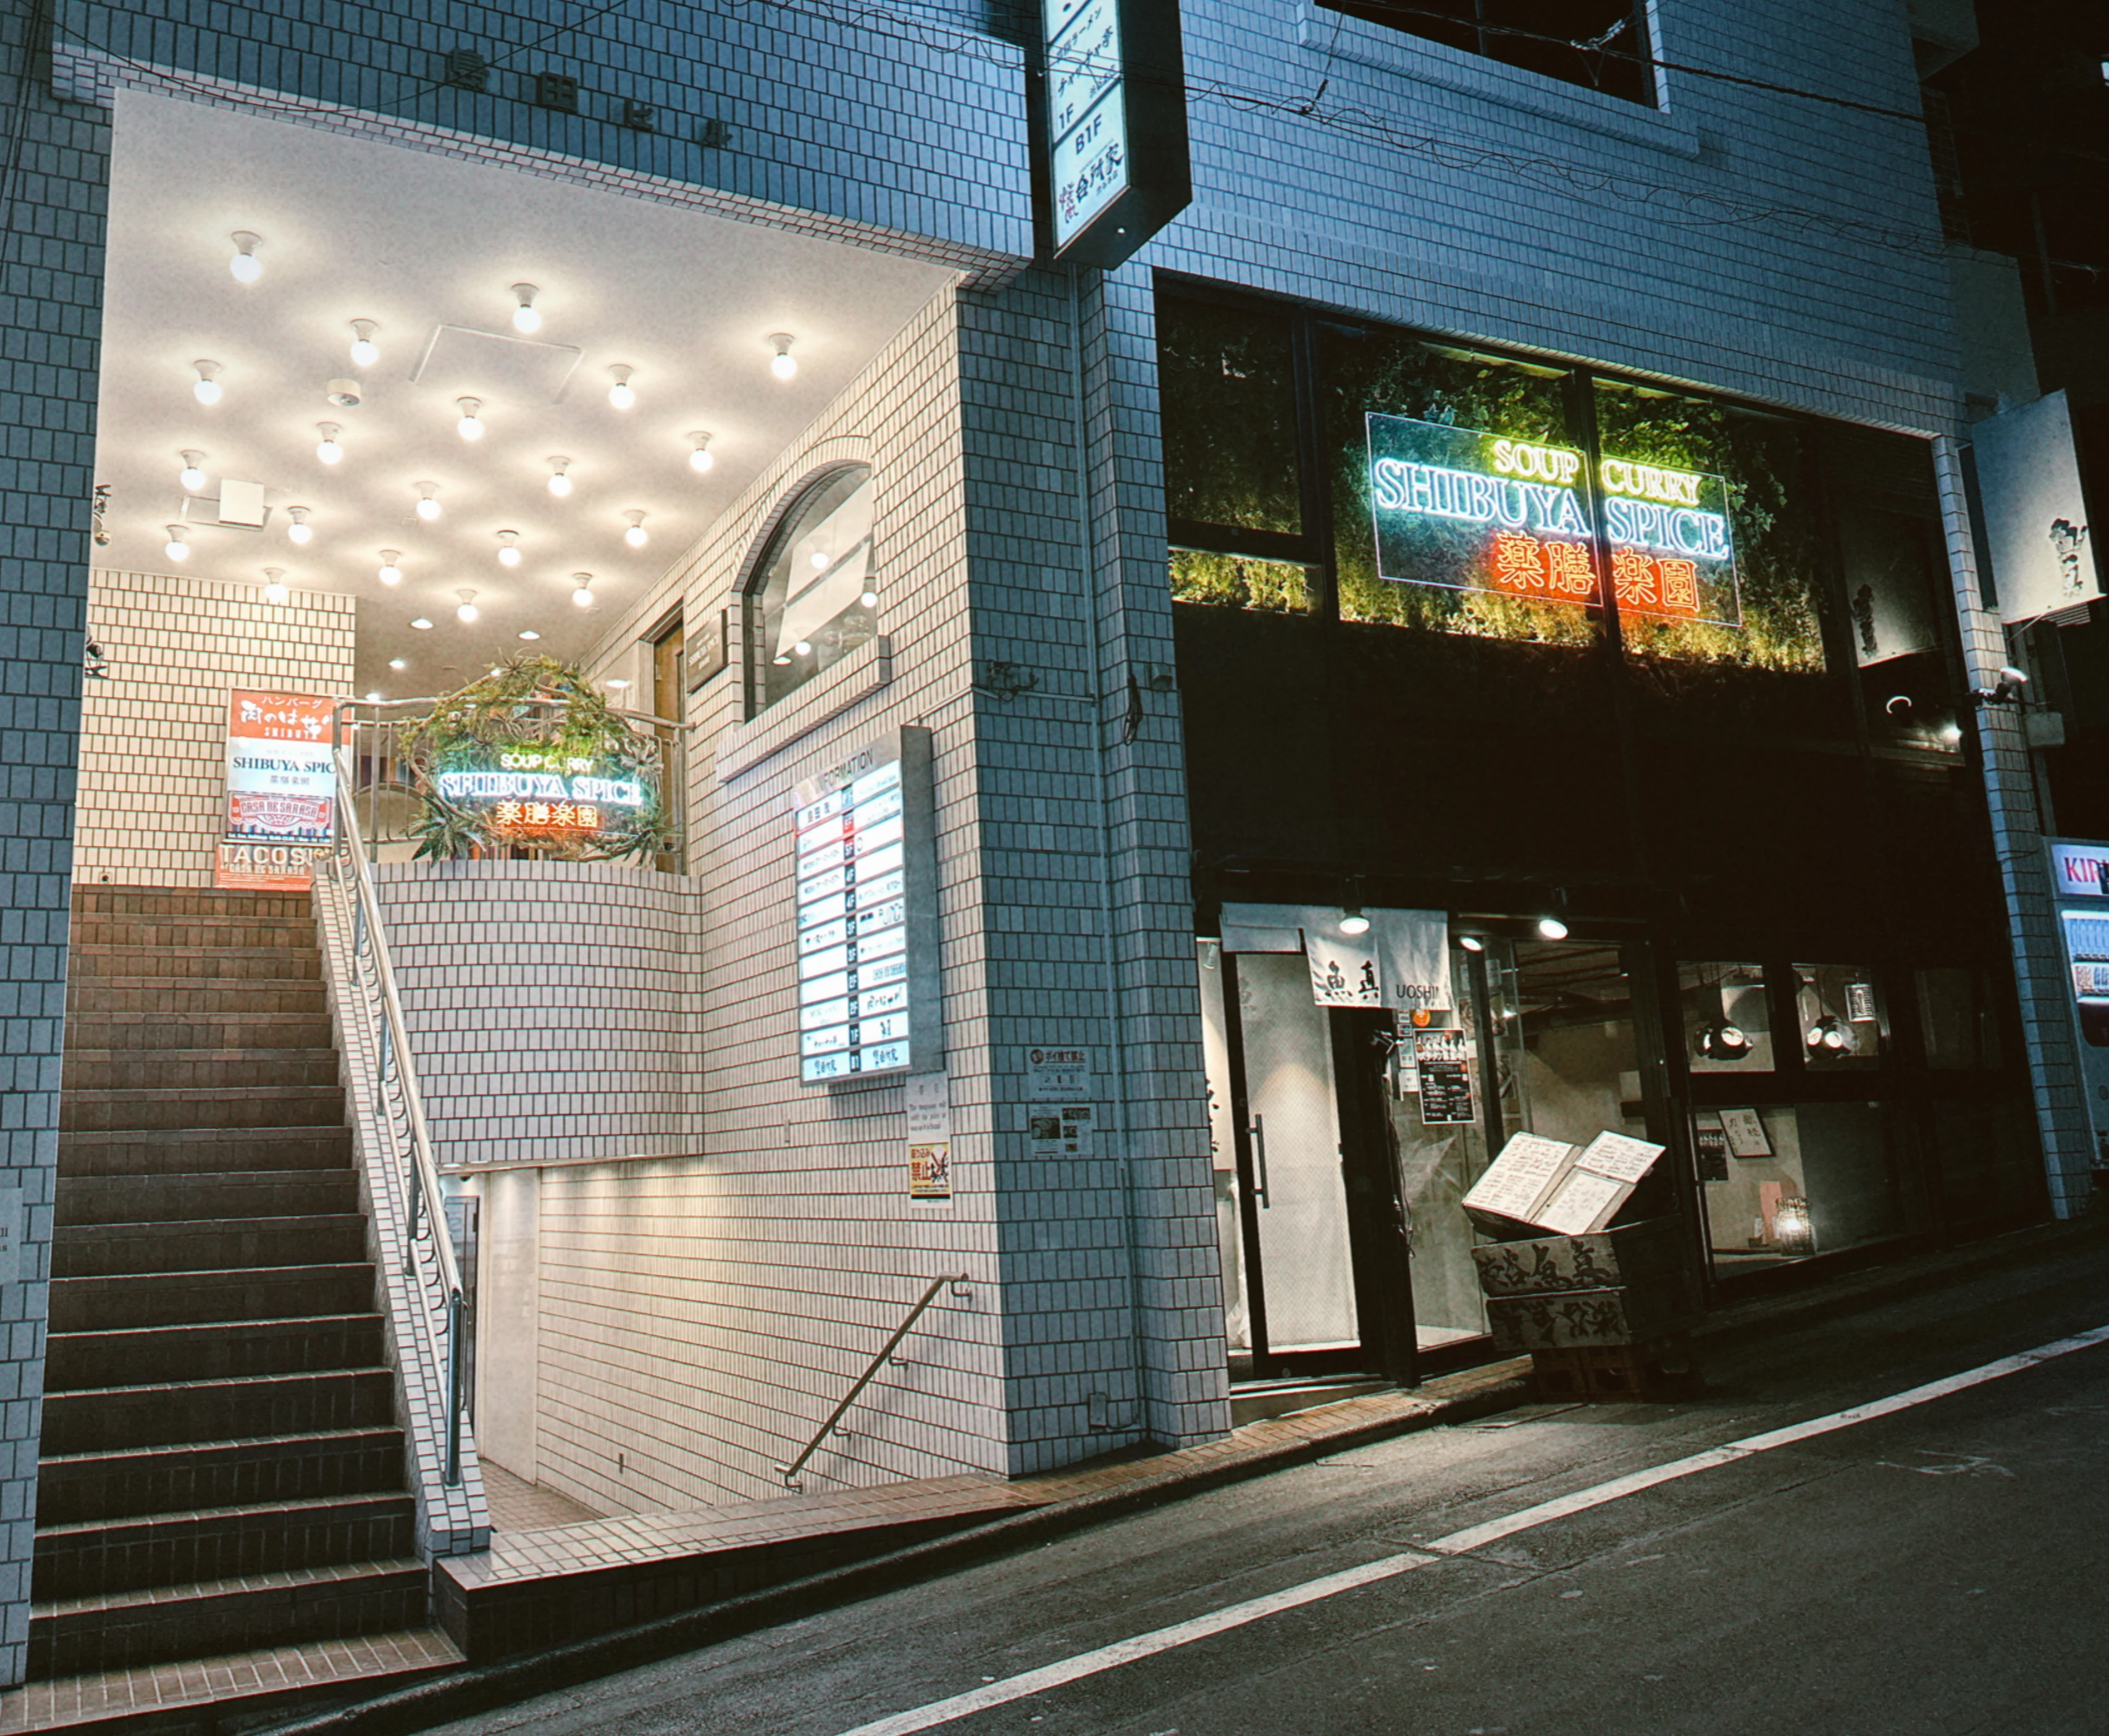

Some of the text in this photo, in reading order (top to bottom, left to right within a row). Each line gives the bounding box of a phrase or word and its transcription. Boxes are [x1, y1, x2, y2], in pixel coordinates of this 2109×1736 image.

[1060, 103, 1074, 129] 1F
[1076, 113, 1103, 155] B1F
[1494, 440, 1702, 507] SOUP CURRY
[1375, 457, 1730, 560] SHIBUYA SPICE
[261, 696, 323, 709] ハンバーグ
[233, 757, 336, 774] SHIBUYA SPIC
[501, 754, 594, 772] SOUP CURRY
[440, 772, 643, 806] SHIBUYA SPICE
[241, 801, 318, 819] CASA DE SARASA
[496, 800, 599, 828] 薬膳楽園
